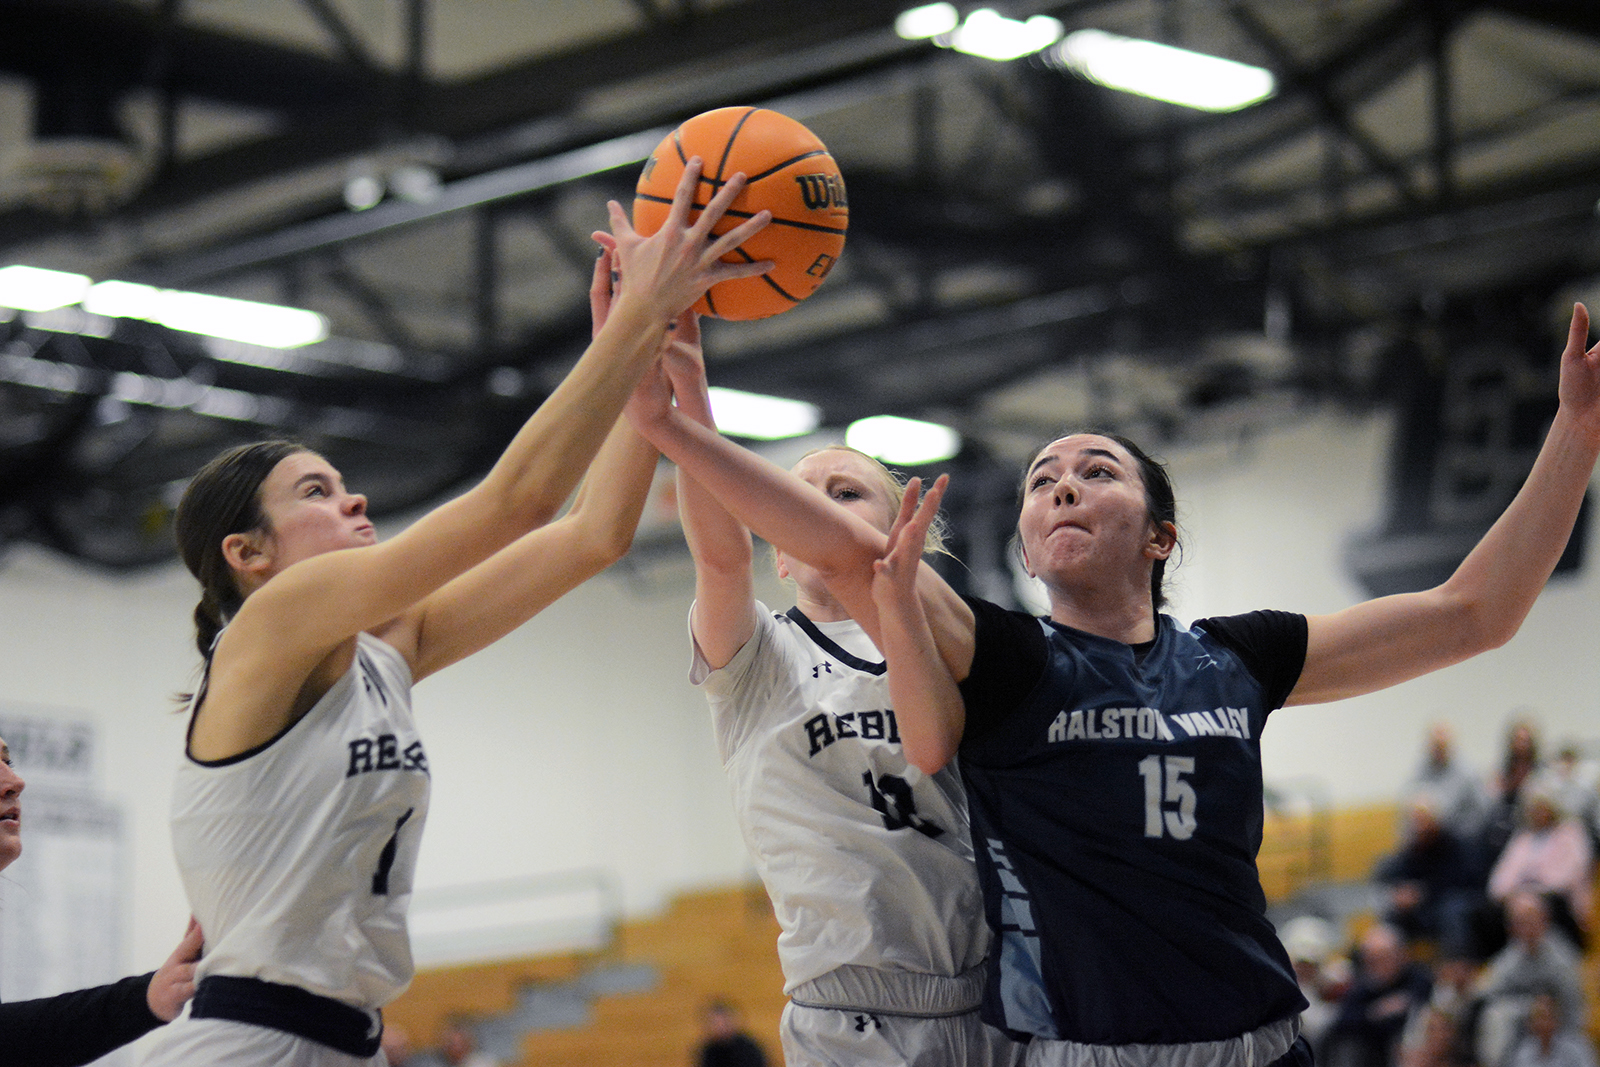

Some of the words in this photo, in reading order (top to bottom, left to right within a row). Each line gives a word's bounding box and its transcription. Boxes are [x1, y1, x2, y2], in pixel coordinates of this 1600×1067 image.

[1048, 707, 1174, 743] RALSTON
[1170, 706, 1250, 740] VALLEY
[1138, 754, 1197, 840] 15
